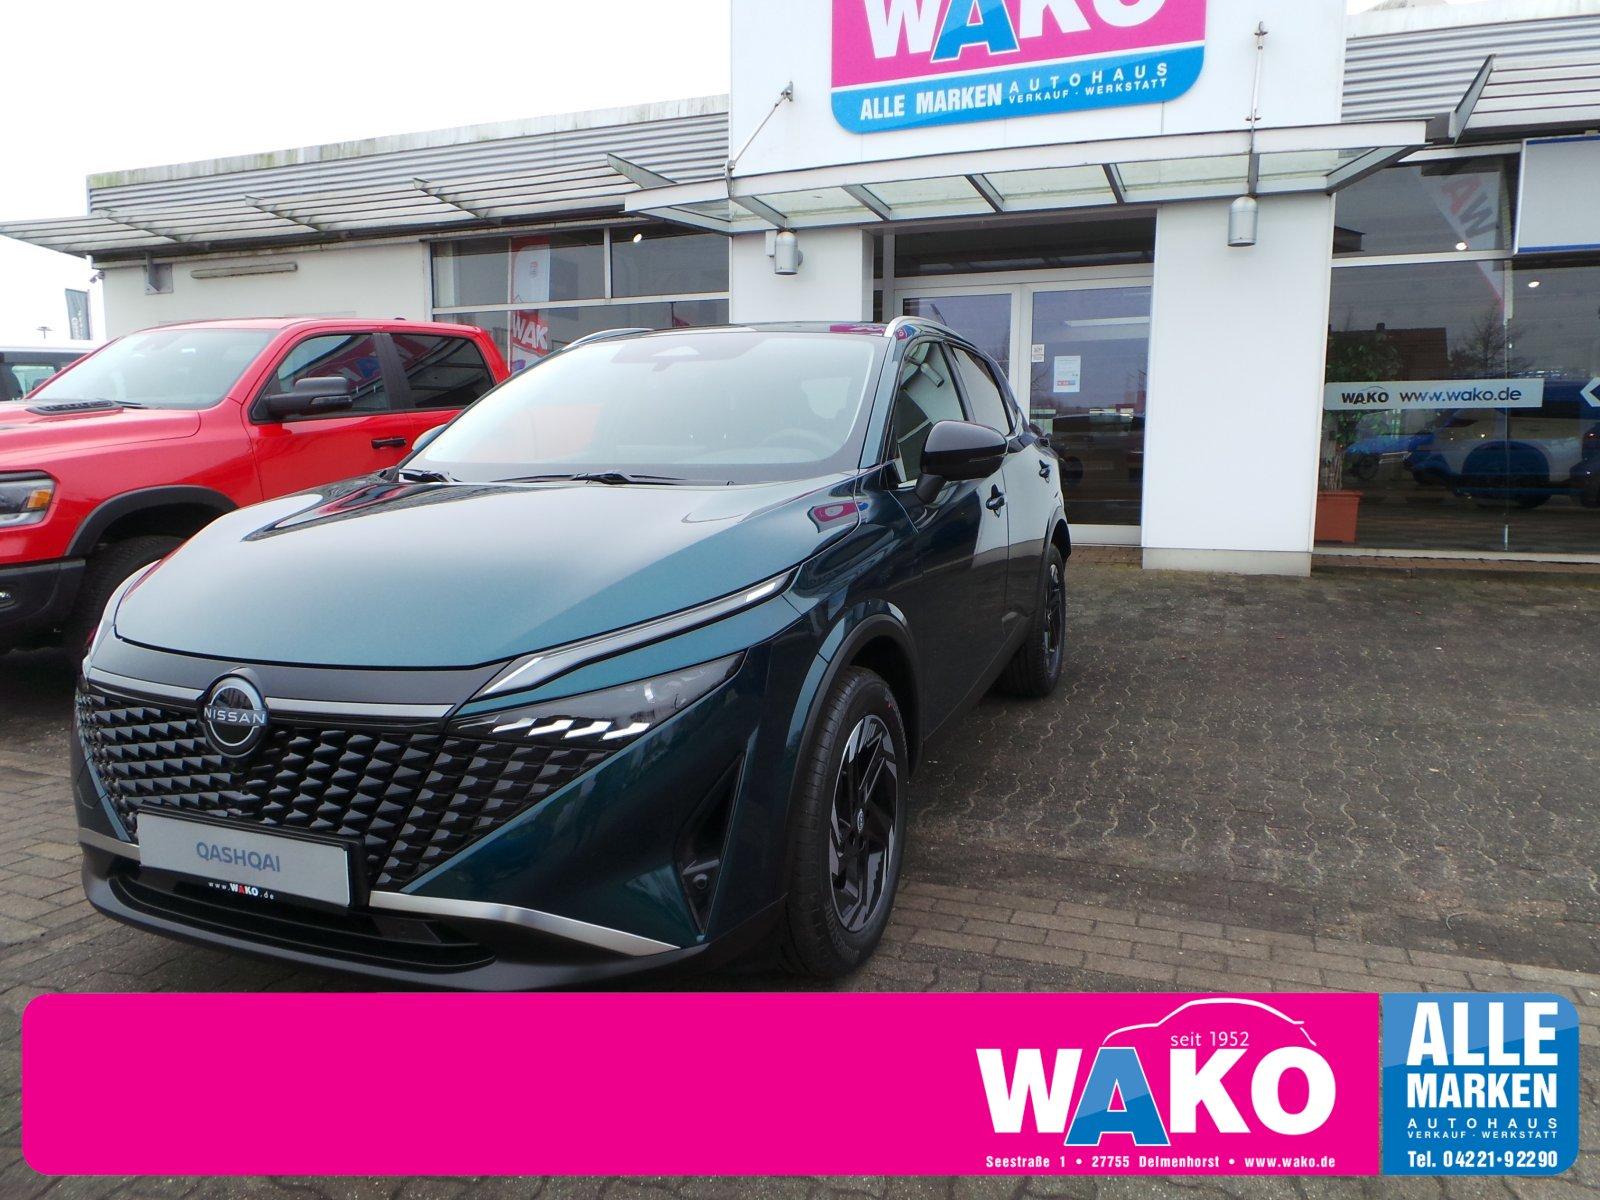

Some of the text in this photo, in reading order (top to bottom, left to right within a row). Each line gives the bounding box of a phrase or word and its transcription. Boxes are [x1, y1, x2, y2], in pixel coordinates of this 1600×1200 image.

[1009, 62, 1168, 94] AUTOHAUS
[1009, 78, 1167, 104] VERKAUF WERKSTATT
[860, 83, 1002, 120] ALLE MARKEN
[1341, 386, 1521, 405] WAKO www.wako.de
[204, 707, 265, 723] NISSAN
[196, 841, 280, 872] QASHQAI
